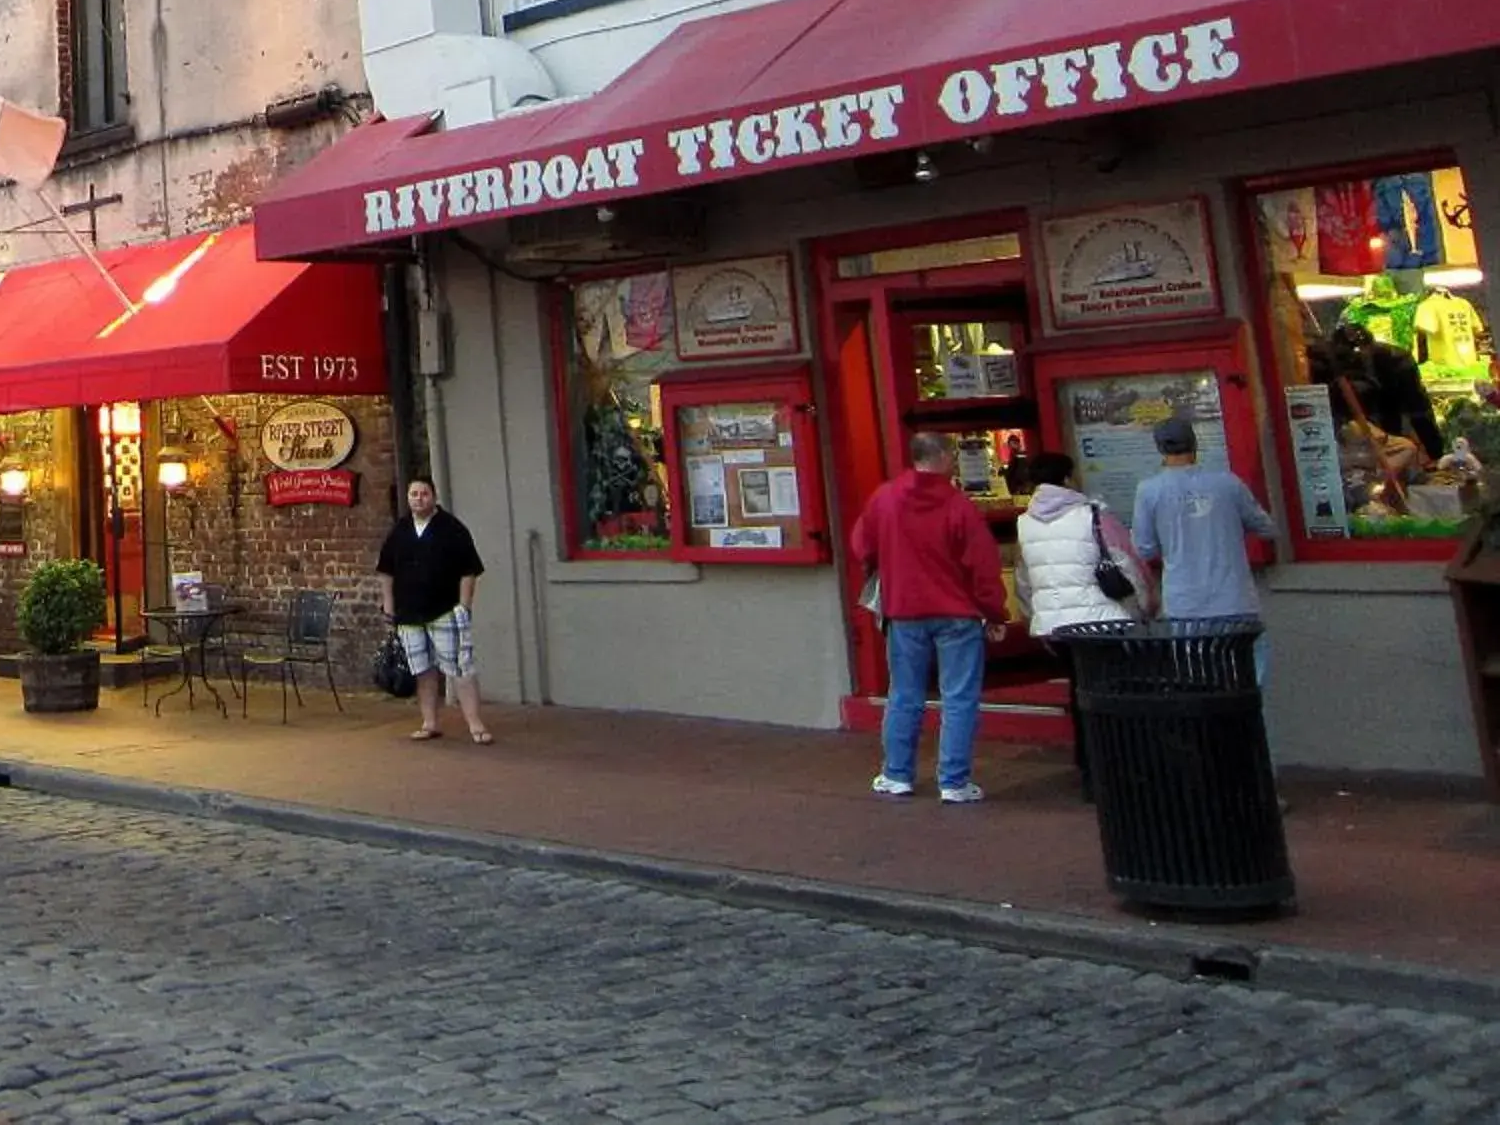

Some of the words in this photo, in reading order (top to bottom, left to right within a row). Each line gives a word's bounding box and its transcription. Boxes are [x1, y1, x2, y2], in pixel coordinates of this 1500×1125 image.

[363, 138, 644, 233] RIVERBOAT
[668, 84, 904, 175] TICKET
[938, 18, 1240, 124] OFFICE
[260, 354, 304, 380] EST
[313, 356, 358, 381] 1973
[269, 422, 301, 442] RIVER
[304, 418, 345, 437] STREET
